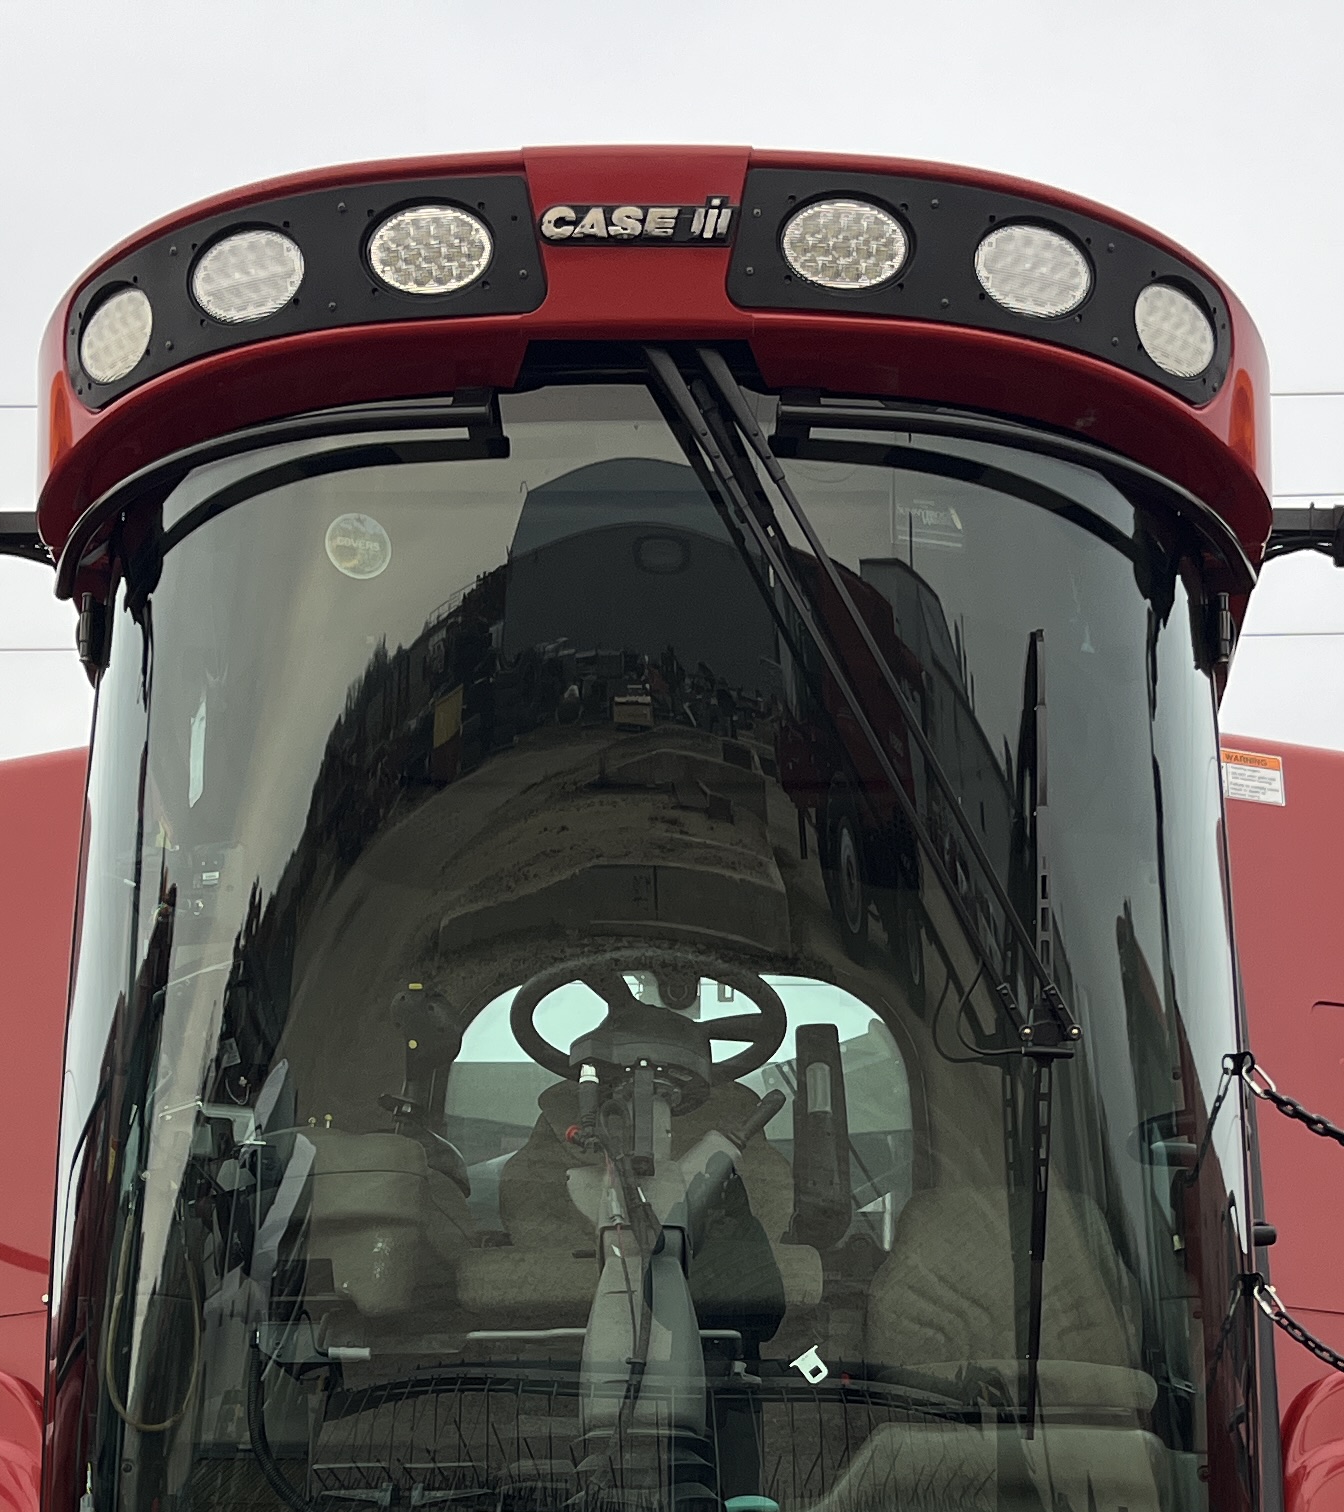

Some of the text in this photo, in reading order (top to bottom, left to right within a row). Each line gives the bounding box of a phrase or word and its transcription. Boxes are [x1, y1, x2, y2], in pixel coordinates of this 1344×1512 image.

[541, 205, 680, 240] CASE
[336, 535, 381, 553] COVERS
[1224, 753, 1268, 768] WARNING
